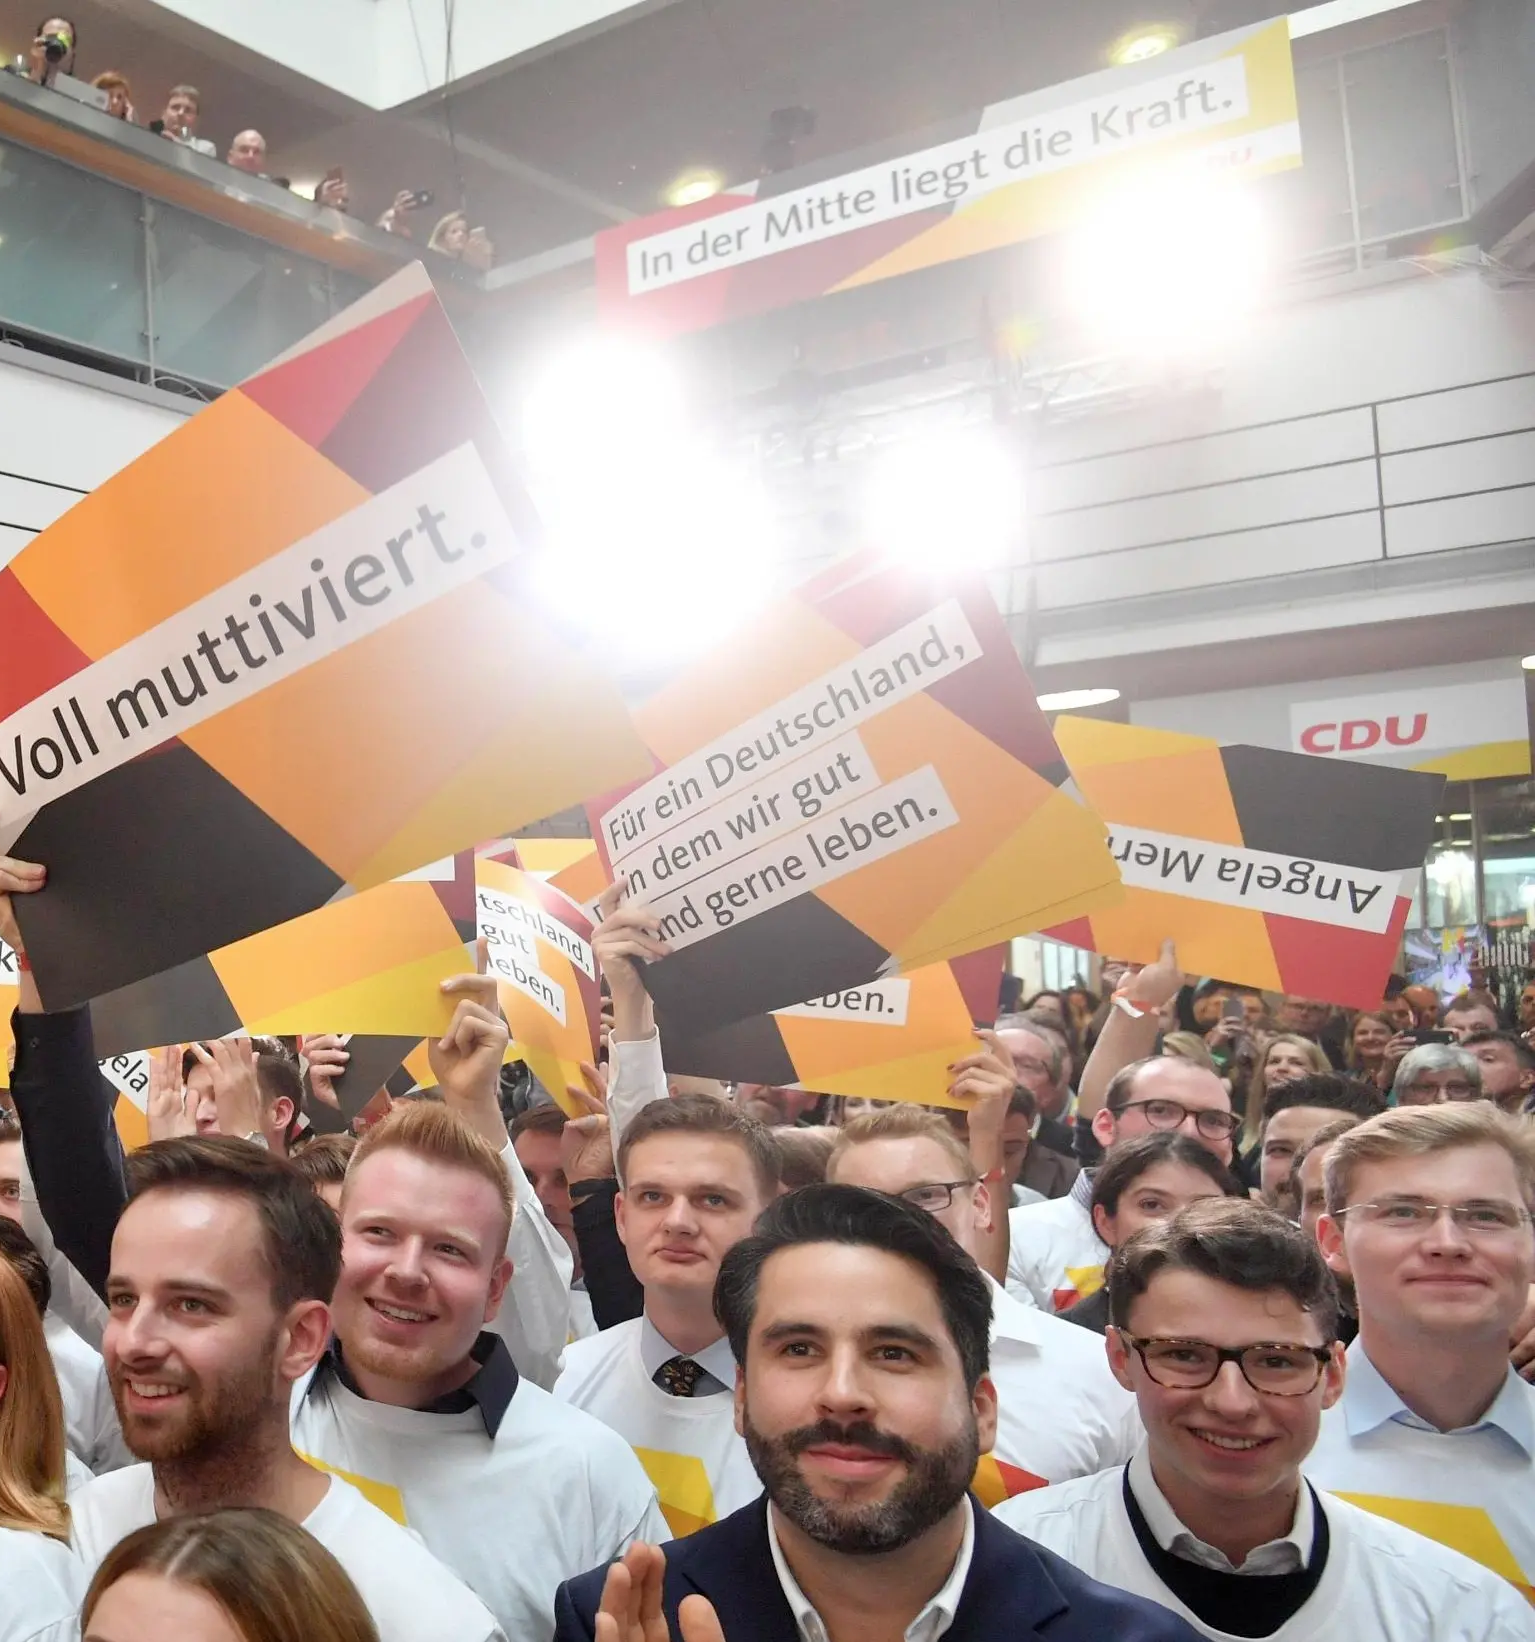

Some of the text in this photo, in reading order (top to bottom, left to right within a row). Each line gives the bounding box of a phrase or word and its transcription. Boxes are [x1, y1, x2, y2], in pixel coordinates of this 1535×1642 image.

[641, 79, 1233, 280] In der Mitte liegt die Kraft.
[107, 503, 488, 740] muttiviert.
[609, 624, 965, 850] Für ein Deutschland,
[1300, 713, 1428, 754] CDU
[644, 798, 938, 942] nd gerne leben.
[652, 829, 723, 881] dem
[725, 793, 781, 840] wir
[792, 753, 861, 818] gut
[481, 924, 531, 954] gut
[1217, 857, 1382, 914] Angela
